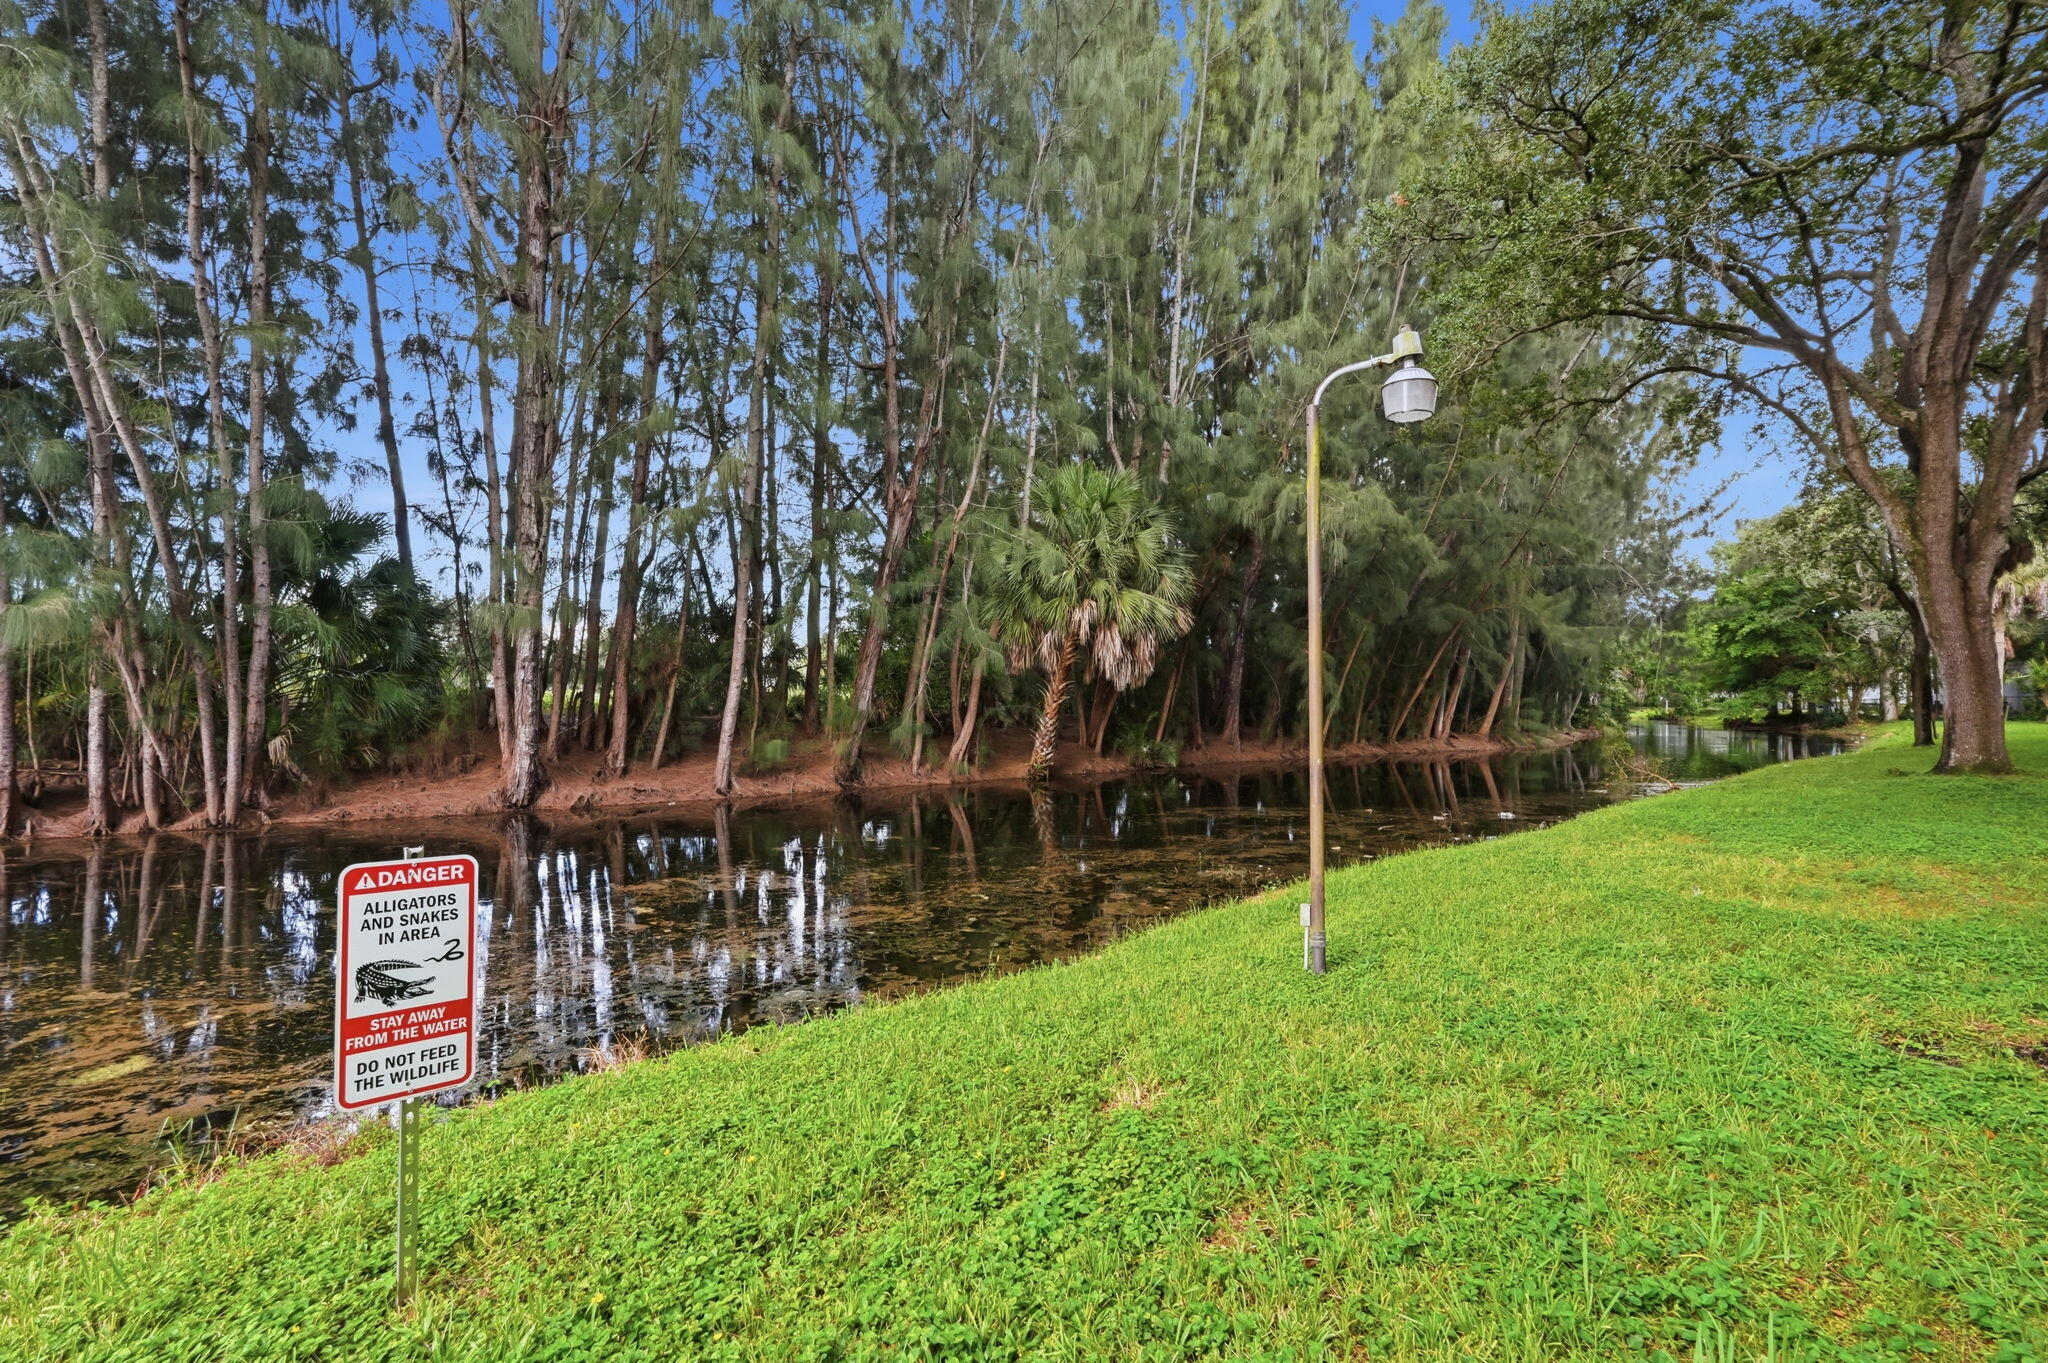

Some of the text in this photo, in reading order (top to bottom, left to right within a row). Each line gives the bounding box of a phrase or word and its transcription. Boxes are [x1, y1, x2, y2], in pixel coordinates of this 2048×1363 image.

[378, 865, 464, 886] DANGER
[364, 894, 456, 915] ALLIGATORS
[361, 909, 458, 931] AND SNAKES
[379, 927, 440, 945] IN AREA
[370, 1007, 446, 1031] STAY AWAY
[346, 1017, 467, 1050] FROM THE WATER
[357, 1044, 456, 1075] DO NOT FEED
[354, 1059, 459, 1092] THE WILDLIFE
